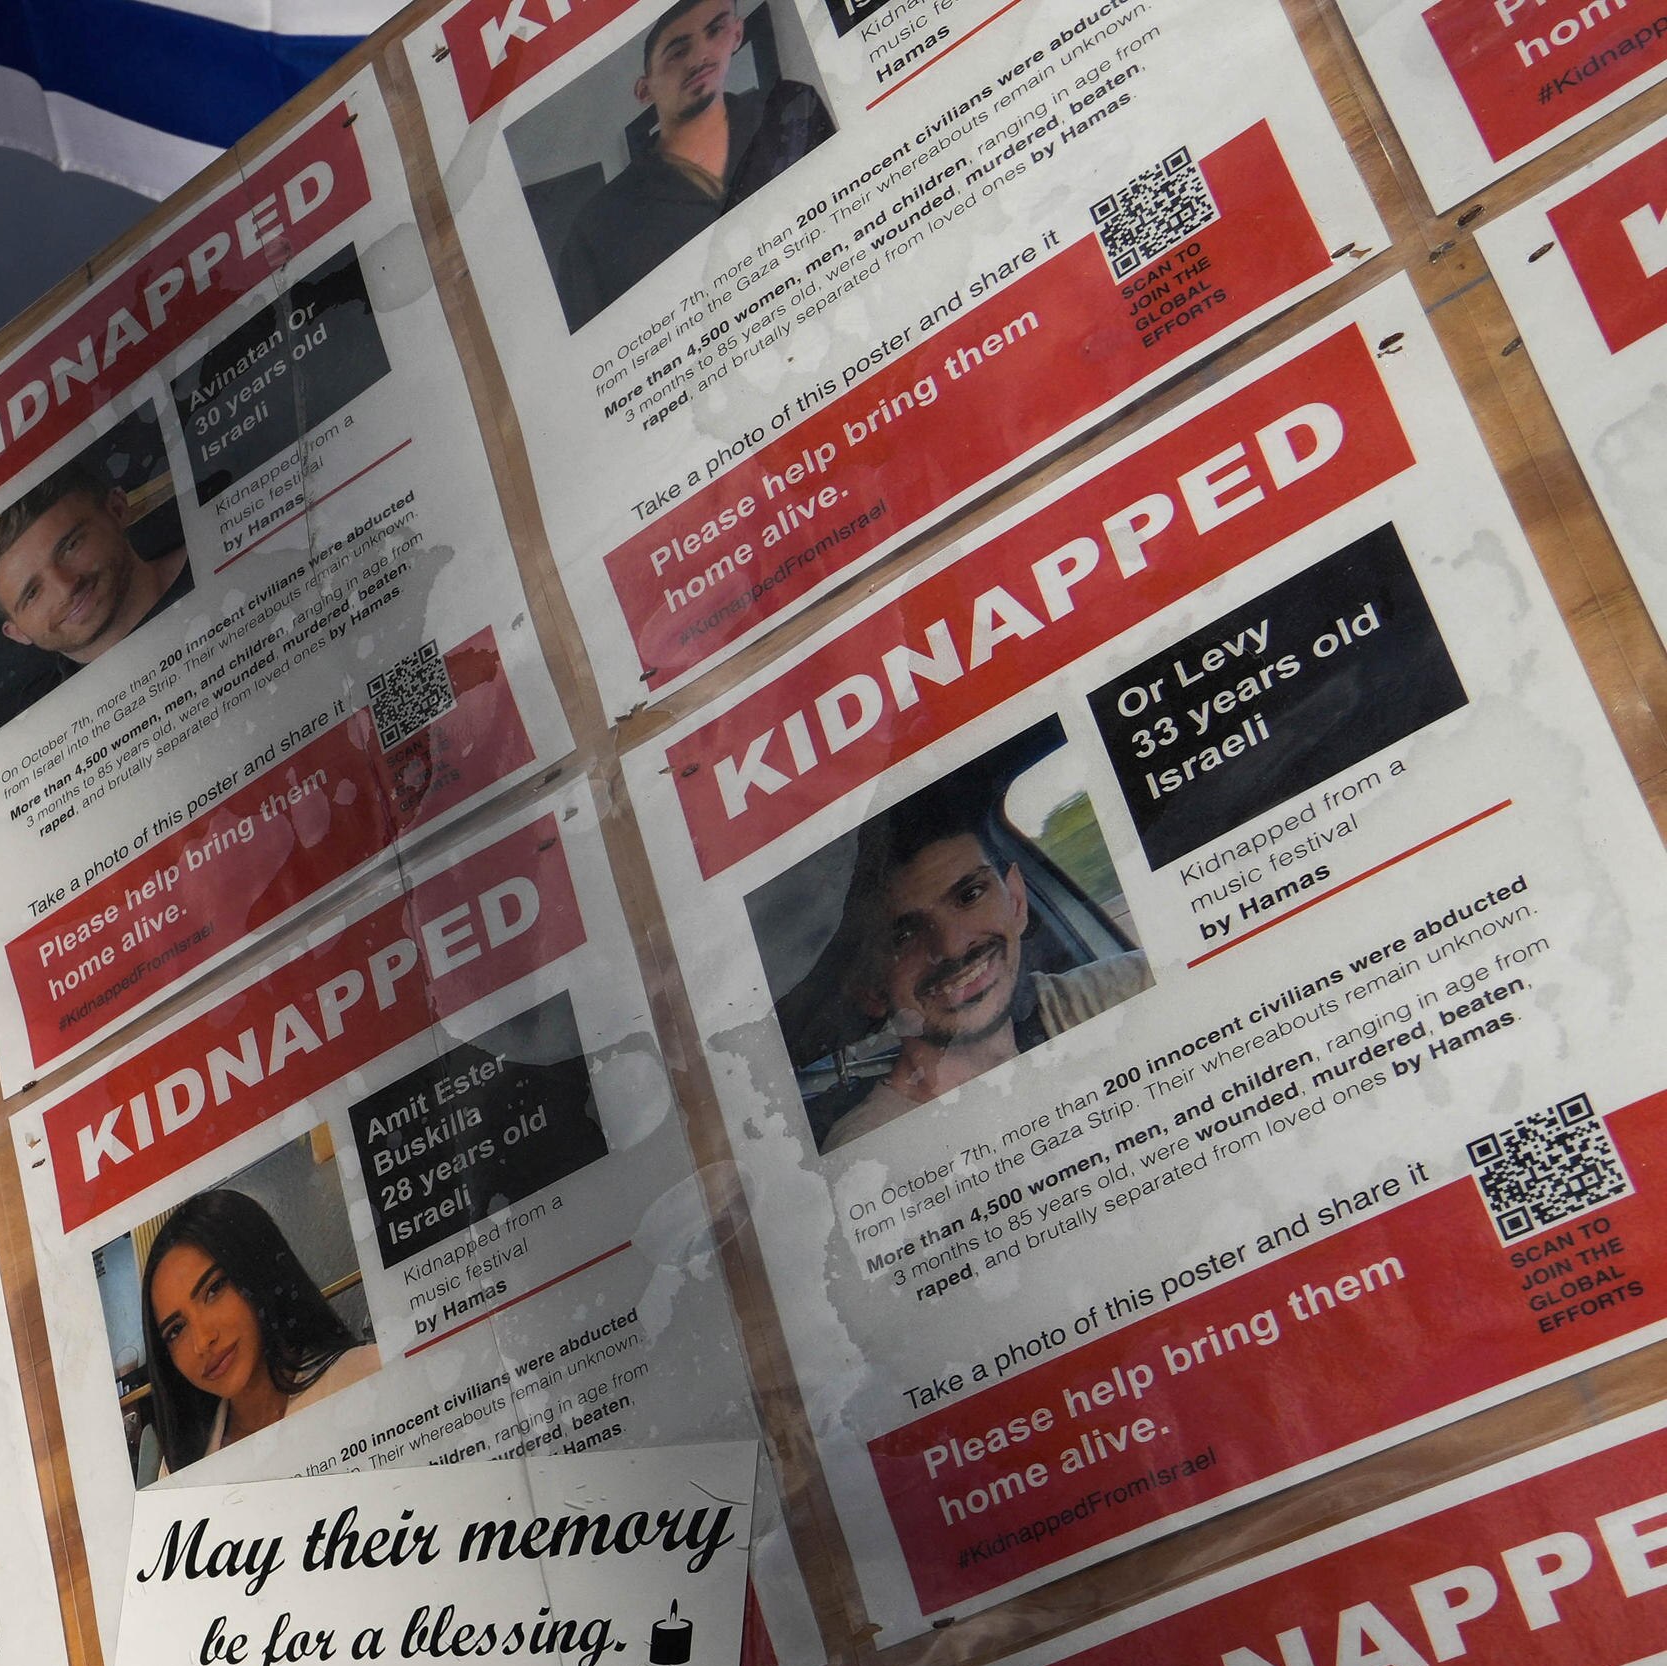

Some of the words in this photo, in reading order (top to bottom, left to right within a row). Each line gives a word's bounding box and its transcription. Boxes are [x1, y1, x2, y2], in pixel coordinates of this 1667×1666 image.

[713, 402, 1344, 820] KIDNAPPED
[1117, 678, 1164, 718] Or
[1173, 618, 1269, 688] Levy
[1131, 716, 1179, 759] 33
[1186, 654, 1301, 736] years
[1312, 602, 1381, 658] old
[1145, 712, 1270, 800] Israeli
[76, 876, 540, 1183] KIDNAPPED
[854, 1216, 896, 1244] from
[900, 1184, 951, 1221] Israel
[954, 1170, 990, 1195] into
[994, 1152, 1026, 1175] the
[1030, 1124, 1084, 1157] Gaza
[1087, 1099, 1140, 1130] Strip.
[1143, 1067, 1195, 1100] Their
[1201, 999, 1339, 1073] whereabouts
[1344, 959, 1421, 1005] remain
[1426, 906, 1538, 964] unknown.
[367, 1092, 430, 1145] Amit
[433, 1052, 507, 1106] Ester
[372, 1102, 485, 1178] Buskilla
[380, 1176, 413, 1212] 28
[418, 1139, 495, 1197] years
[503, 1104, 547, 1145] old
[388, 1183, 495, 1245] Israeli
[923, 1407, 1054, 1479] Please
[1062, 1364, 1154, 1419] help
[1161, 1308, 1280, 1376] bring
[1286, 1256, 1405, 1321] them
[938, 1462, 1049, 1526] home
[1059, 1417, 1170, 1474] alive.
[136, 1517, 286, 1597] May
[302, 1505, 441, 1573] their
[458, 1506, 735, 1574] memory
[199, 1615, 249, 1666] be
[351, 1627, 386, 1661] a
